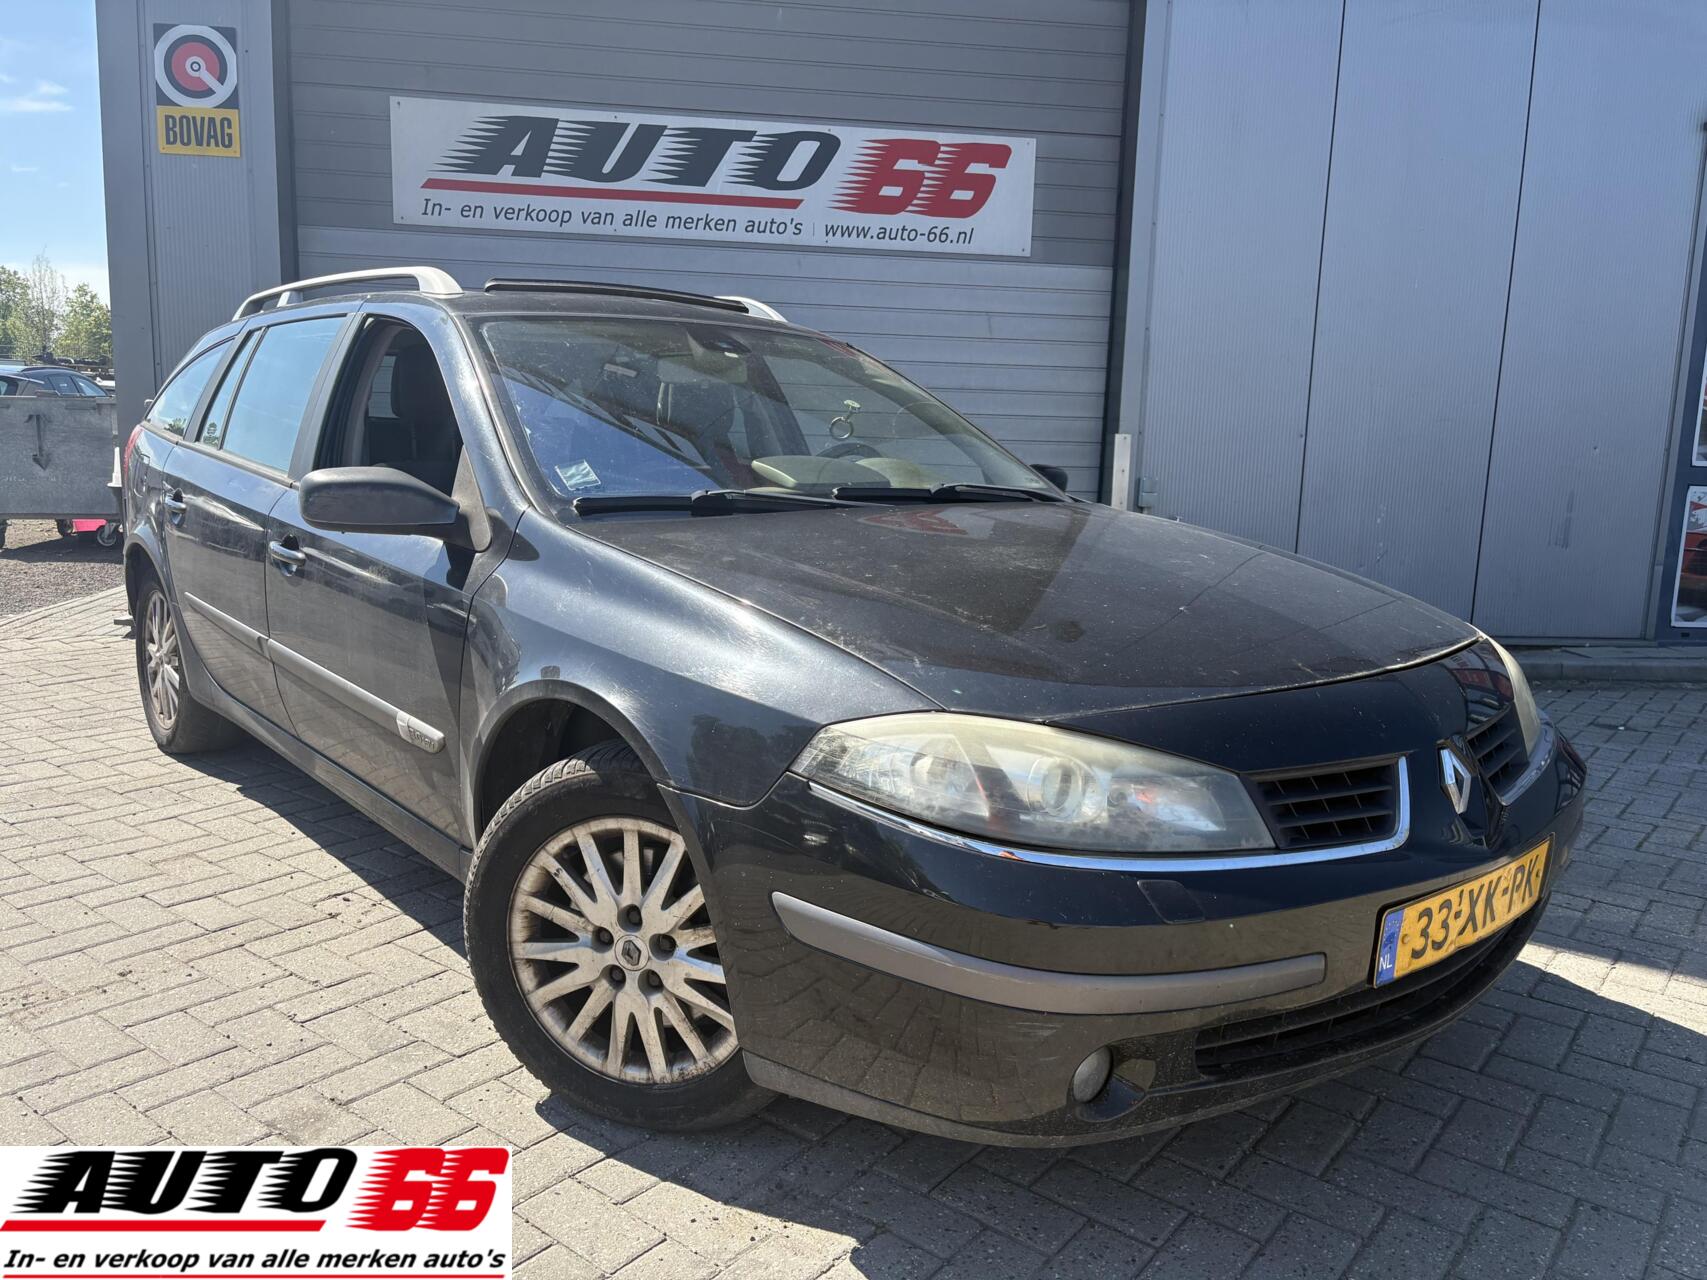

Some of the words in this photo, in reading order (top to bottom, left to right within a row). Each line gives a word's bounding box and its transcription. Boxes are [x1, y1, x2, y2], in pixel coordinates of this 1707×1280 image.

[164, 114, 233, 148] BOVAG
[428, 115, 841, 190] AUTO
[827, 138, 1012, 218] 66
[421, 199, 452, 217] In-
[460, 203, 484, 219] en
[493, 204, 572, 227] verkoop
[581, 210, 614, 226] van
[622, 212, 657, 228] alle
[664, 214, 736, 232] merken
[744, 218, 803, 235] auto's
[824, 222, 974, 245] www.auto-66.nl
[1411, 855, 1539, 960] 33-XK-PK
[1380, 955, 1393, 972] NL
